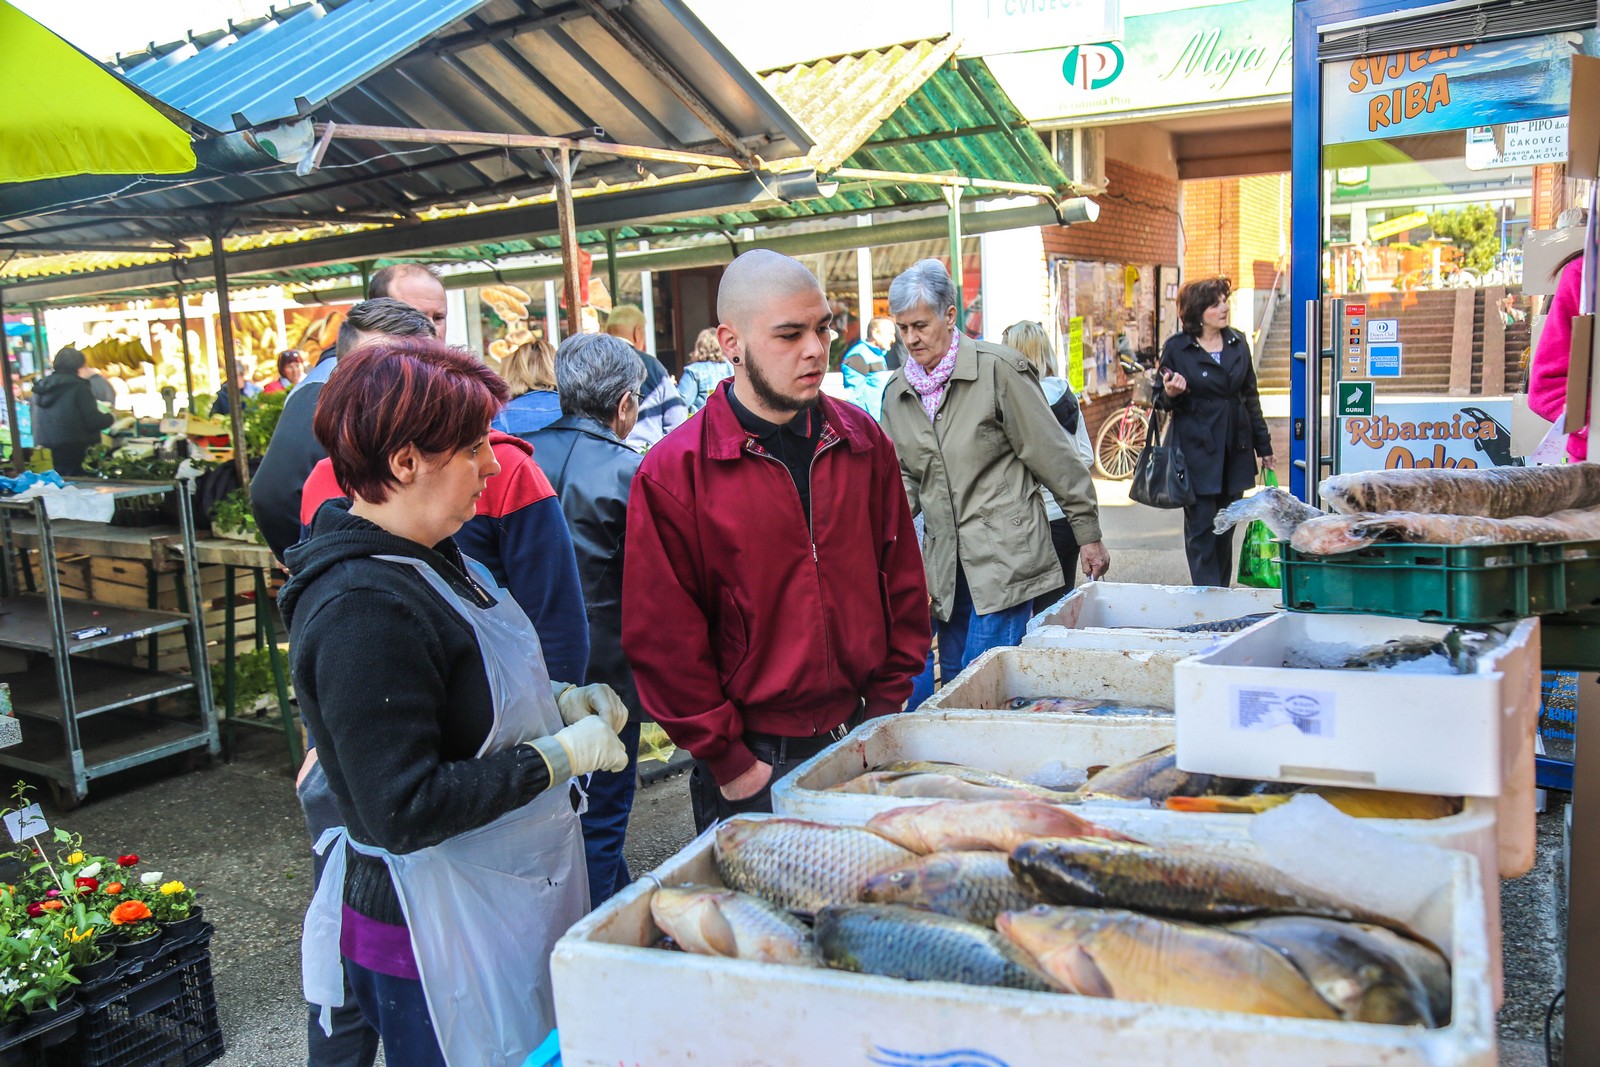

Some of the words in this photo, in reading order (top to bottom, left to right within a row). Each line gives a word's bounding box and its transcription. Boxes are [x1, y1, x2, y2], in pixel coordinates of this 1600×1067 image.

[1158, 27, 1268, 92] Moja
[1368, 73, 1451, 132] RIBA
[1505, 124, 1519, 135] tuj
[1528, 119, 1553, 132] PIPO
[1510, 135, 1561, 148] ČAKOVEC
[1345, 413, 1498, 449] Ribarnica
